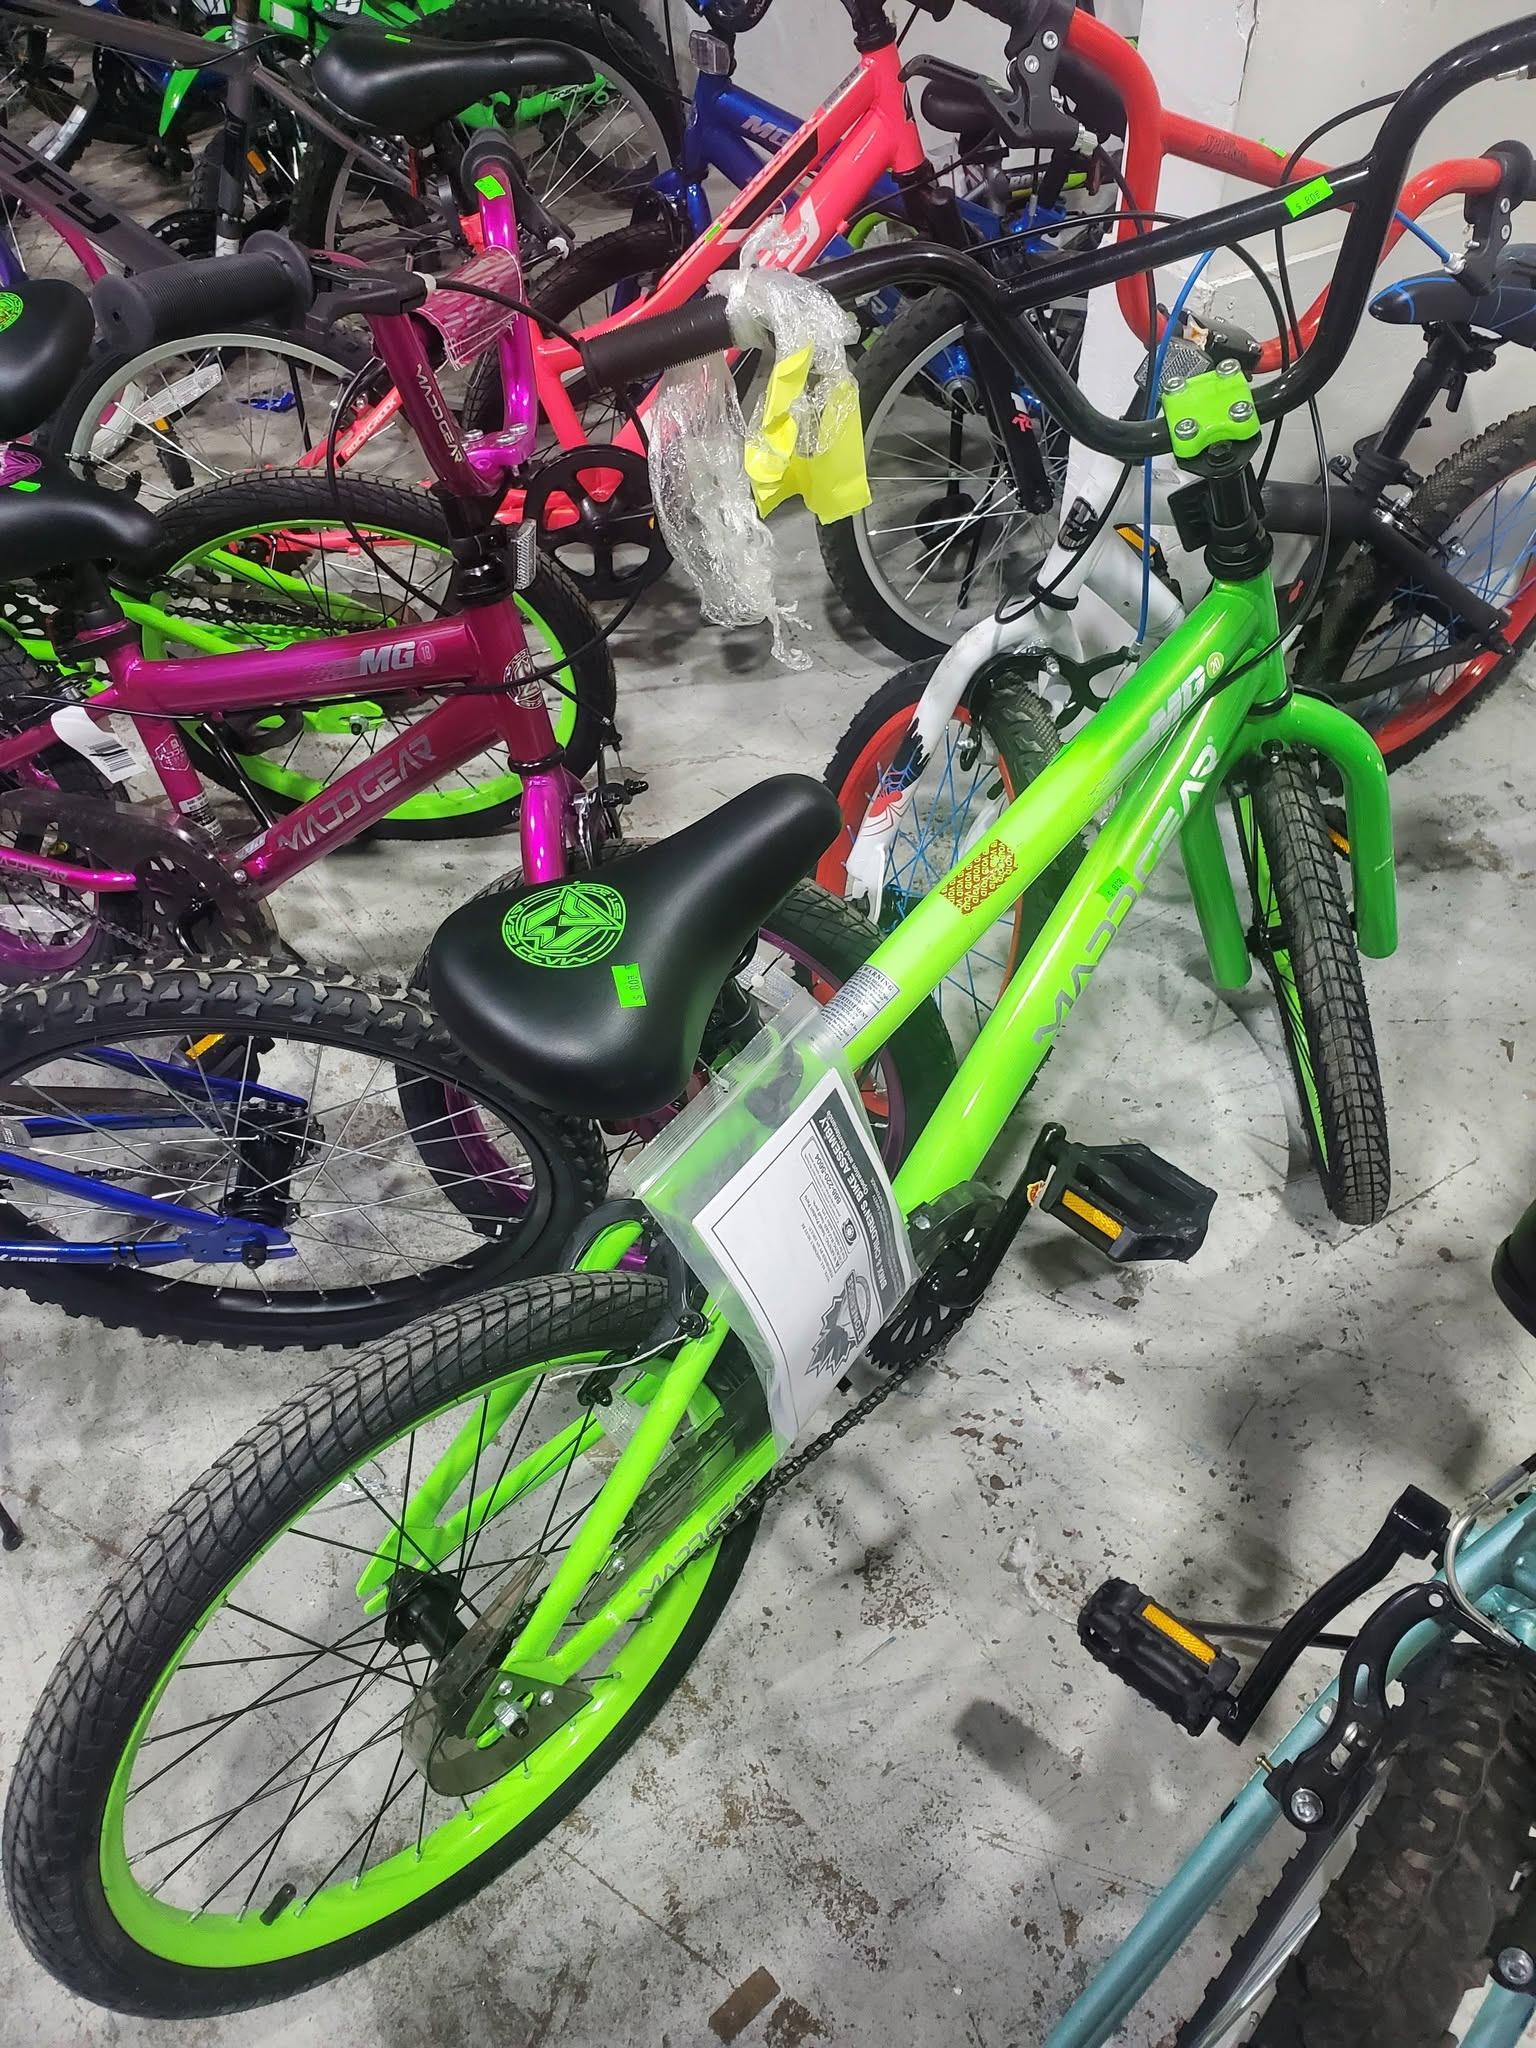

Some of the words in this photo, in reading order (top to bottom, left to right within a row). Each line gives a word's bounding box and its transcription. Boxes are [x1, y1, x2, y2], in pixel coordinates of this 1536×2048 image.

[360, 641, 416, 676] MG
[818, 1117, 851, 1173] ASSEMBLY
[846, 1172, 864, 1202] BIKE
